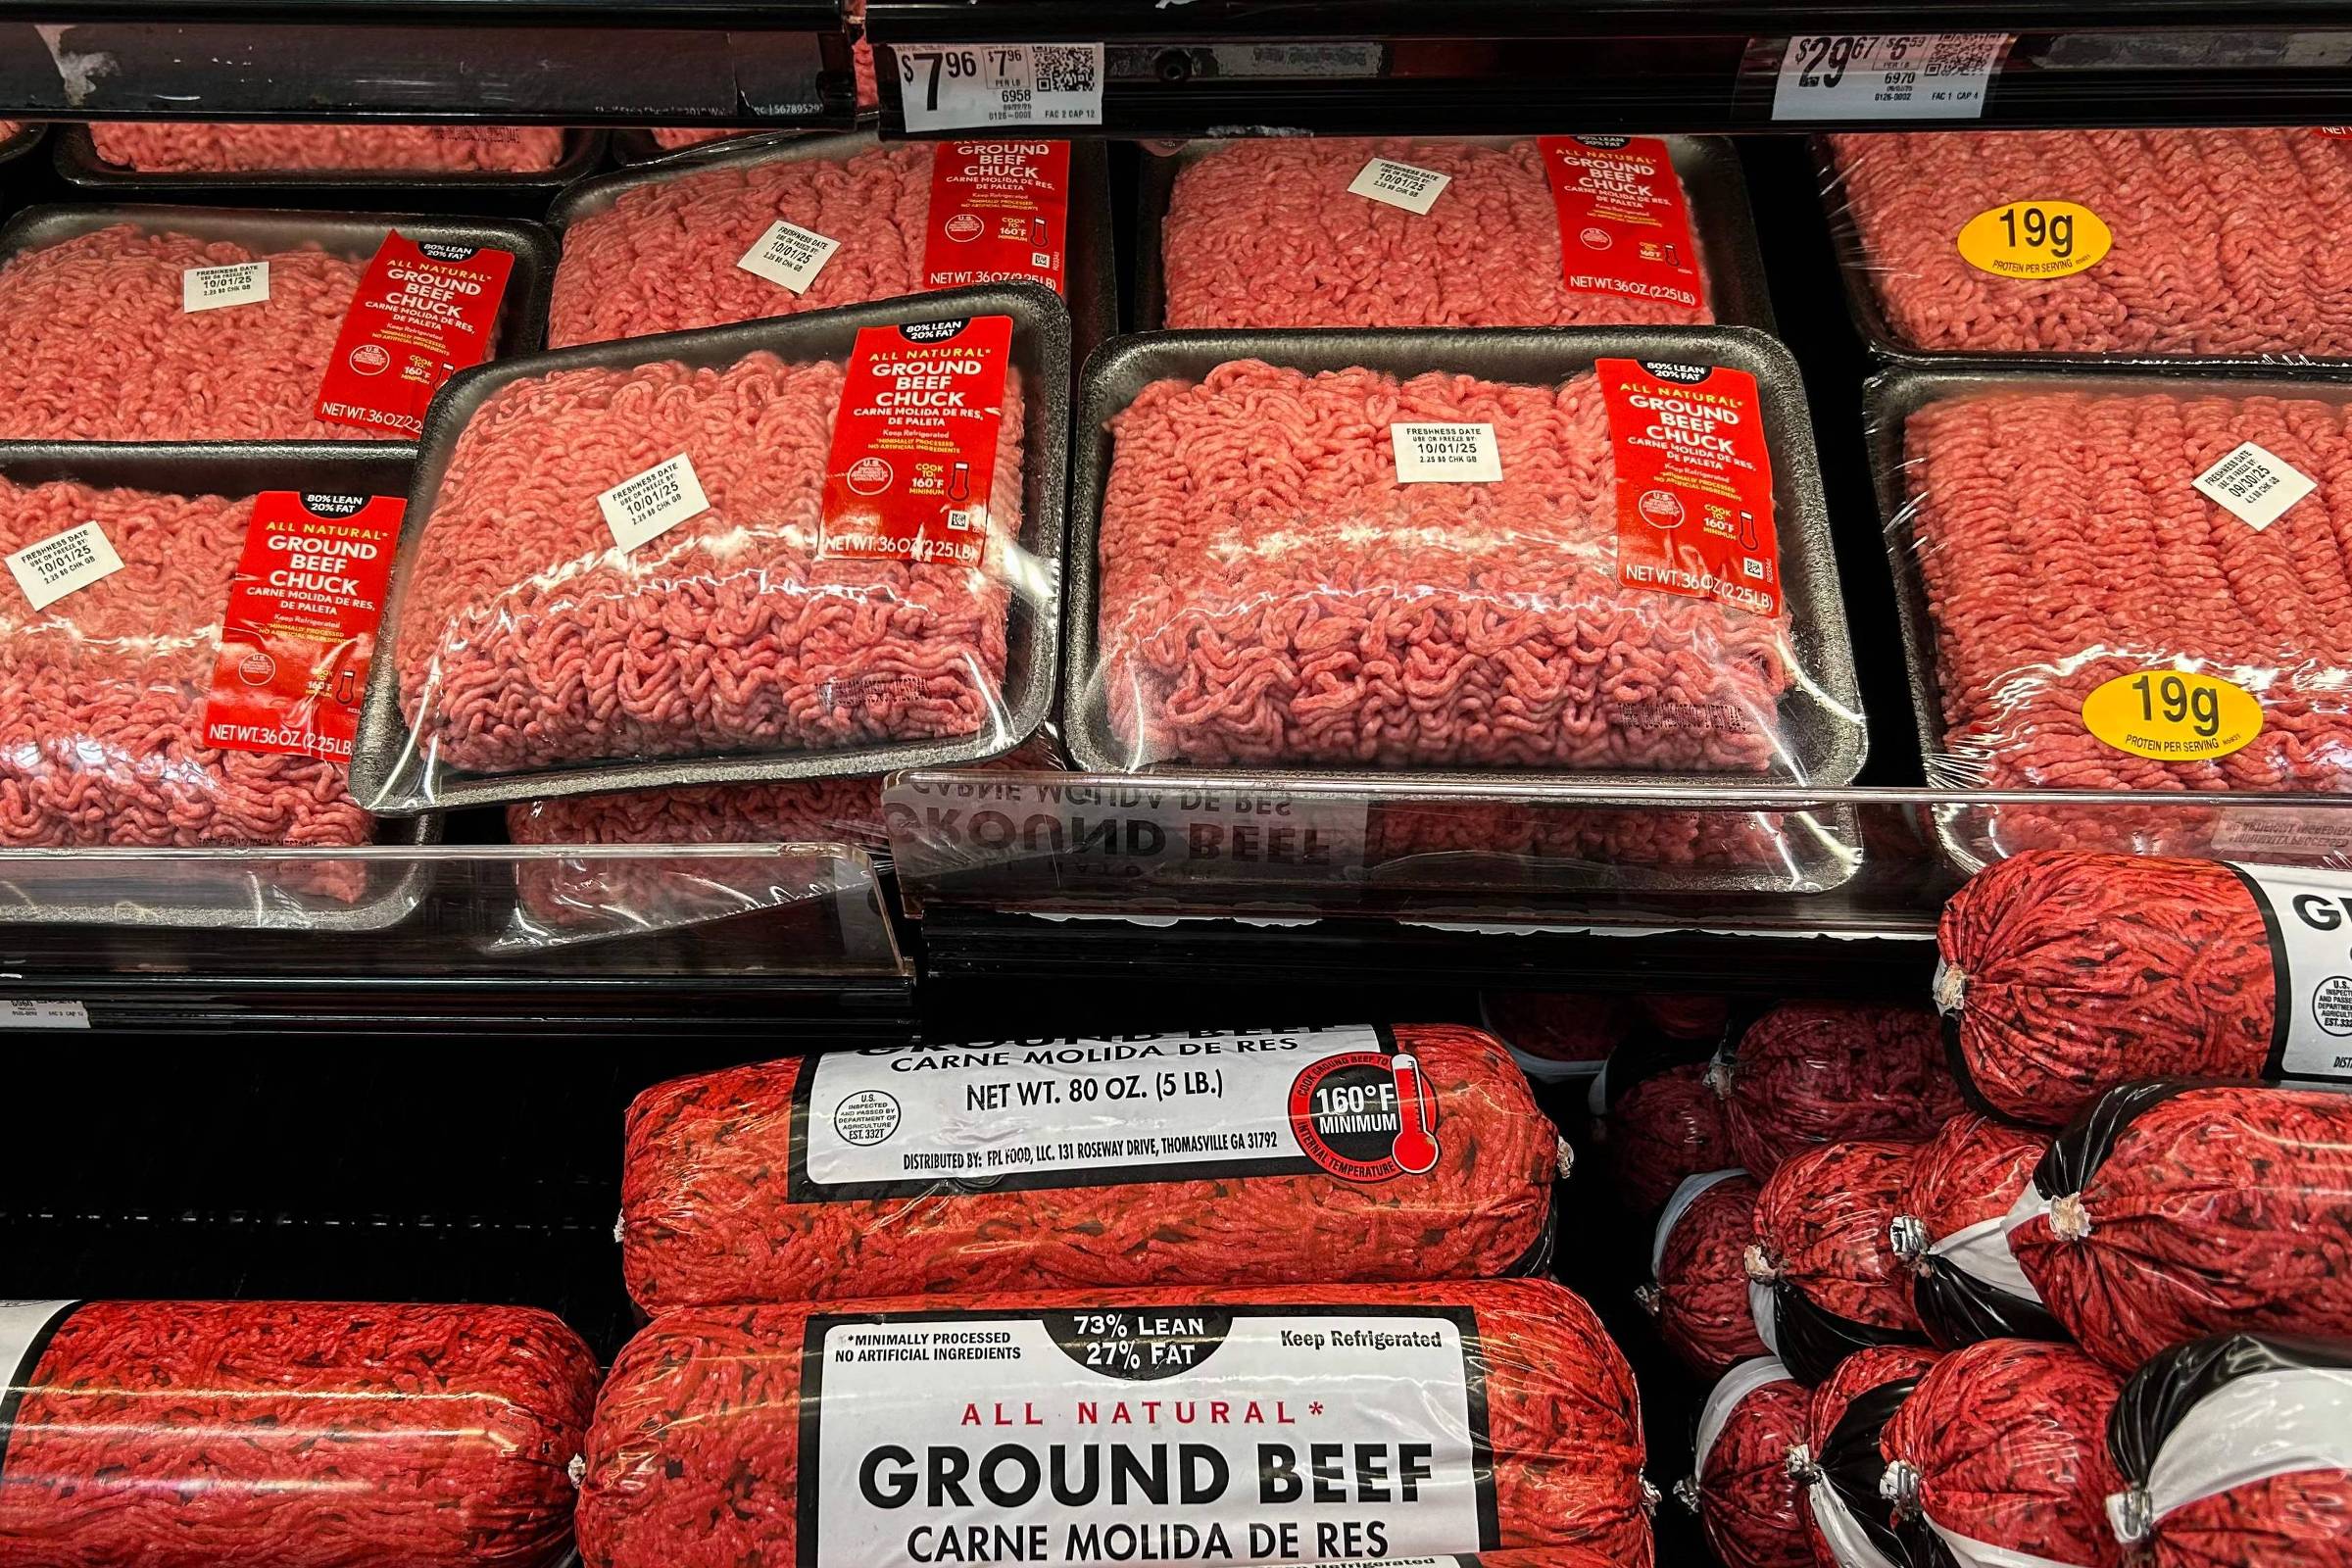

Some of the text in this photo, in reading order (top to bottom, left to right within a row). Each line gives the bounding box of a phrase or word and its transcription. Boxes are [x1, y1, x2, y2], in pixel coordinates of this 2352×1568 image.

[1885, 73, 1915, 83] 6970
[1002, 90, 1031, 102] 6958
[957, 145, 1050, 155] GROUND
[980, 155, 1026, 165] BEEF
[1564, 157, 1655, 175] GROUND
[964, 166, 1039, 178] CHUCK
[1590, 169, 1636, 183] BEEF
[1380, 172, 1425, 192] 10/01/25
[1579, 177, 1652, 196] CHUCK
[778, 226, 828, 250] FRESHNESS DATE
[1999, 208, 2073, 258] 19g
[446, 245, 472, 254] LEAN
[771, 241, 812, 264] 10/01/25
[1992, 260, 2024, 272] PROTEIN
[2026, 264, 2040, 273] PER
[2041, 259, 2073, 272] SERVING
[204, 276, 251, 288] 10/01/25
[387, 269, 481, 295] GROUND
[405, 282, 454, 302] BEEF
[386, 292, 463, 318] CHUCK
[906, 320, 961, 333] 80% LEAN
[869, 352, 898, 362] ALL
[872, 361, 982, 376] GROUND
[1647, 362, 1704, 374] 80% LEAN
[1681, 372, 1700, 381] FAT
[896, 376, 952, 390] BEEF
[875, 392, 966, 407] CHUCK
[895, 408, 940, 416] MOLIDA
[942, 408, 957, 416] DE
[1629, 395, 1740, 425] GROUND
[906, 417, 945, 426] PALETA
[1660, 413, 1715, 434] BEEF
[1418, 443, 1477, 453] 10/01/25
[1646, 425, 1736, 456] CHUCK
[2205, 450, 2252, 486] FRESHNESS DATE
[612, 463, 678, 501] FRESHNESS DATE
[2229, 465, 2270, 498] 09/30/25
[307, 494, 363, 505] 80% LEAN
[627, 481, 678, 514] 10/01/25
[657, 501, 670, 511] CHK
[311, 503, 355, 514] 20% FAT
[266, 521, 295, 532] ALL
[22, 530, 89, 564] FRESHNESS DATE
[268, 535, 377, 560] GROUND
[38, 545, 91, 575] 10/01/25
[70, 561, 84, 571] CHK
[290, 554, 348, 573] BEEF
[270, 570, 360, 596] CHUCK
[1626, 564, 1699, 589] NET 36
[2132, 675, 2220, 736] 19g
[210, 724, 236, 740] NET
[2126, 734, 2161, 752] PROTEIN
[2164, 742, 2181, 752] PER
[2183, 738, 2220, 752] SERVING
[2333, 980, 2350, 989] U.S.
[891, 1052, 1009, 1072] CARNE
[1023, 1045, 1164, 1065] MOLIDA
[1179, 1042, 1221, 1055] DE
[1236, 1038, 1298, 1053] RES
[1298, 1075, 1315, 1098] COOK
[1314, 1059, 1348, 1076] GROUND
[861, 1094, 875, 1102] U.S.
[966, 1068, 1223, 1110] NET WT. 80 OZ. (5 LB.)
[1316, 1083, 1395, 1114] 160°F
[1320, 1113, 1396, 1134] MINIMUM
[850, 1130, 863, 1139] EST.
[904, 1132, 1277, 1170] DISTRIBUTED BY: FPL FOOD, LLC. 131 ROSEWAY DRIVE, THOMASVILLE GA 31792
[1298, 1121, 1396, 1177] INTERNAL TEMPERATURE
[1074, 1314, 1203, 1338] 73% LEAN
[933, 1332, 1010, 1345] PROCESSED
[1281, 1330, 1442, 1350] Keep Refrigerated
[835, 1348, 1020, 1362] NO ARTIFICIAL INGREDIENTS
[1086, 1342, 1195, 1370] 27% FAT
[961, 1402, 1043, 1425] ALL
[858, 1443, 1433, 1509] GROUND BEEF
[907, 1521, 1388, 1562] CARNE MOLIDA DE RES
